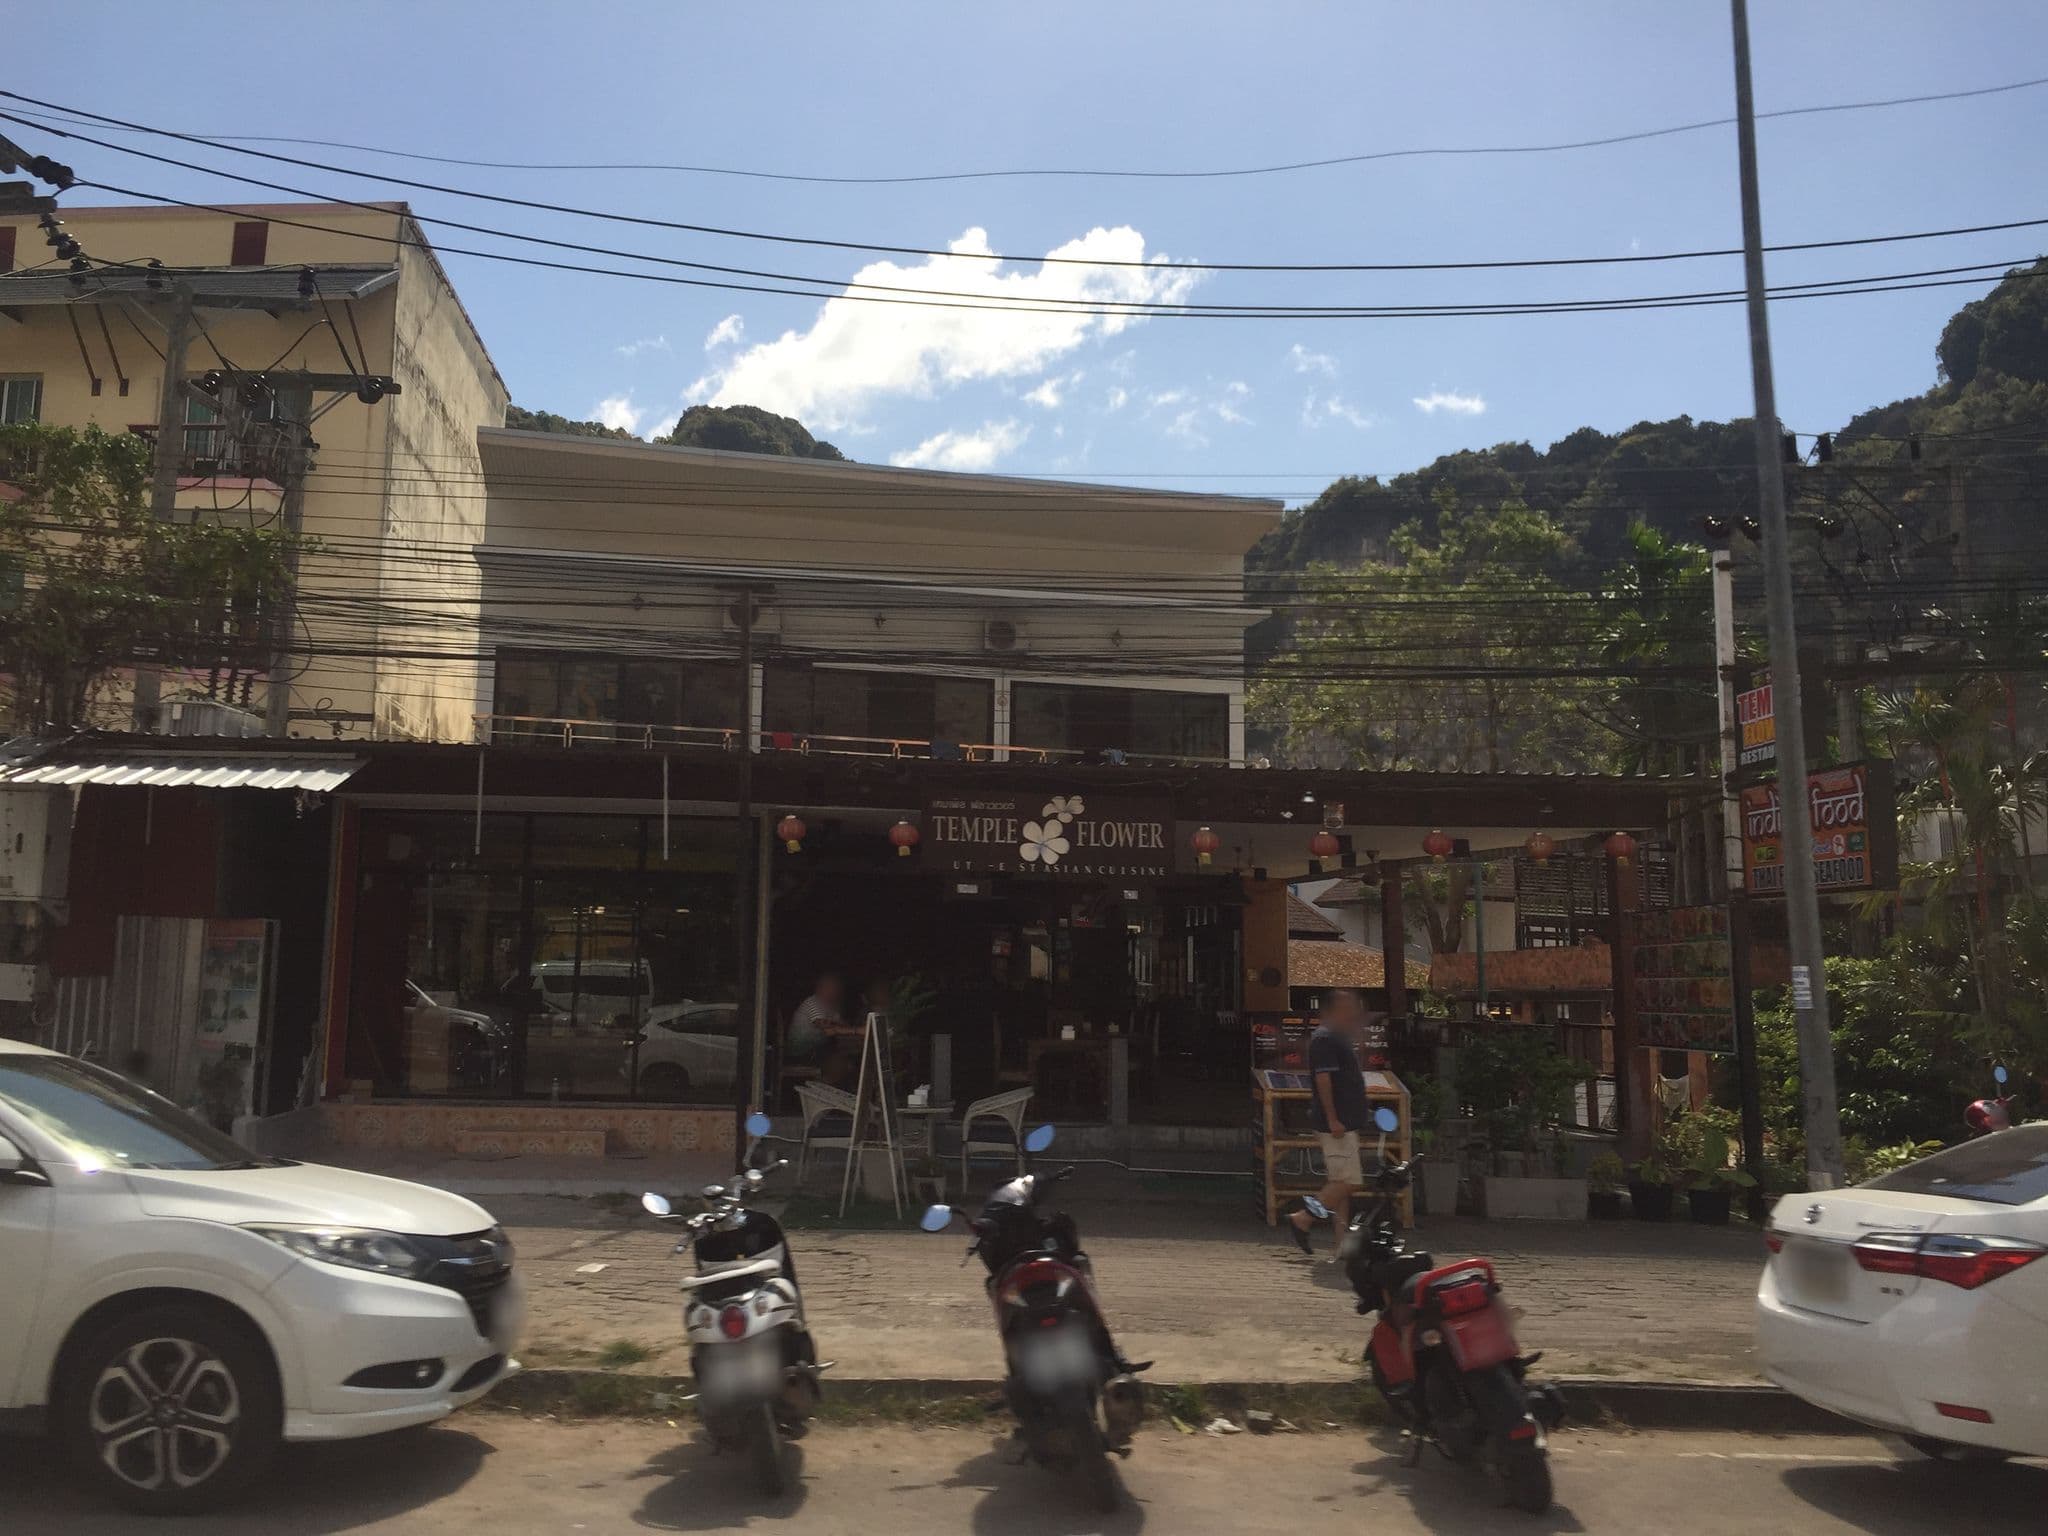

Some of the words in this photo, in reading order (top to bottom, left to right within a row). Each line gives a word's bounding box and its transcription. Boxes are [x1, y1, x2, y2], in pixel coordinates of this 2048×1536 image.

[1737, 685, 1775, 724] TEM
[1740, 744, 1776, 766] RESTAU
[1747, 789, 1782, 837] indi
[1811, 773, 1865, 827] food
[932, 815, 1018, 844] TEMPLE
[1076, 820, 1165, 849] FLOWER
[1098, 866, 1167, 877] CUISINE
